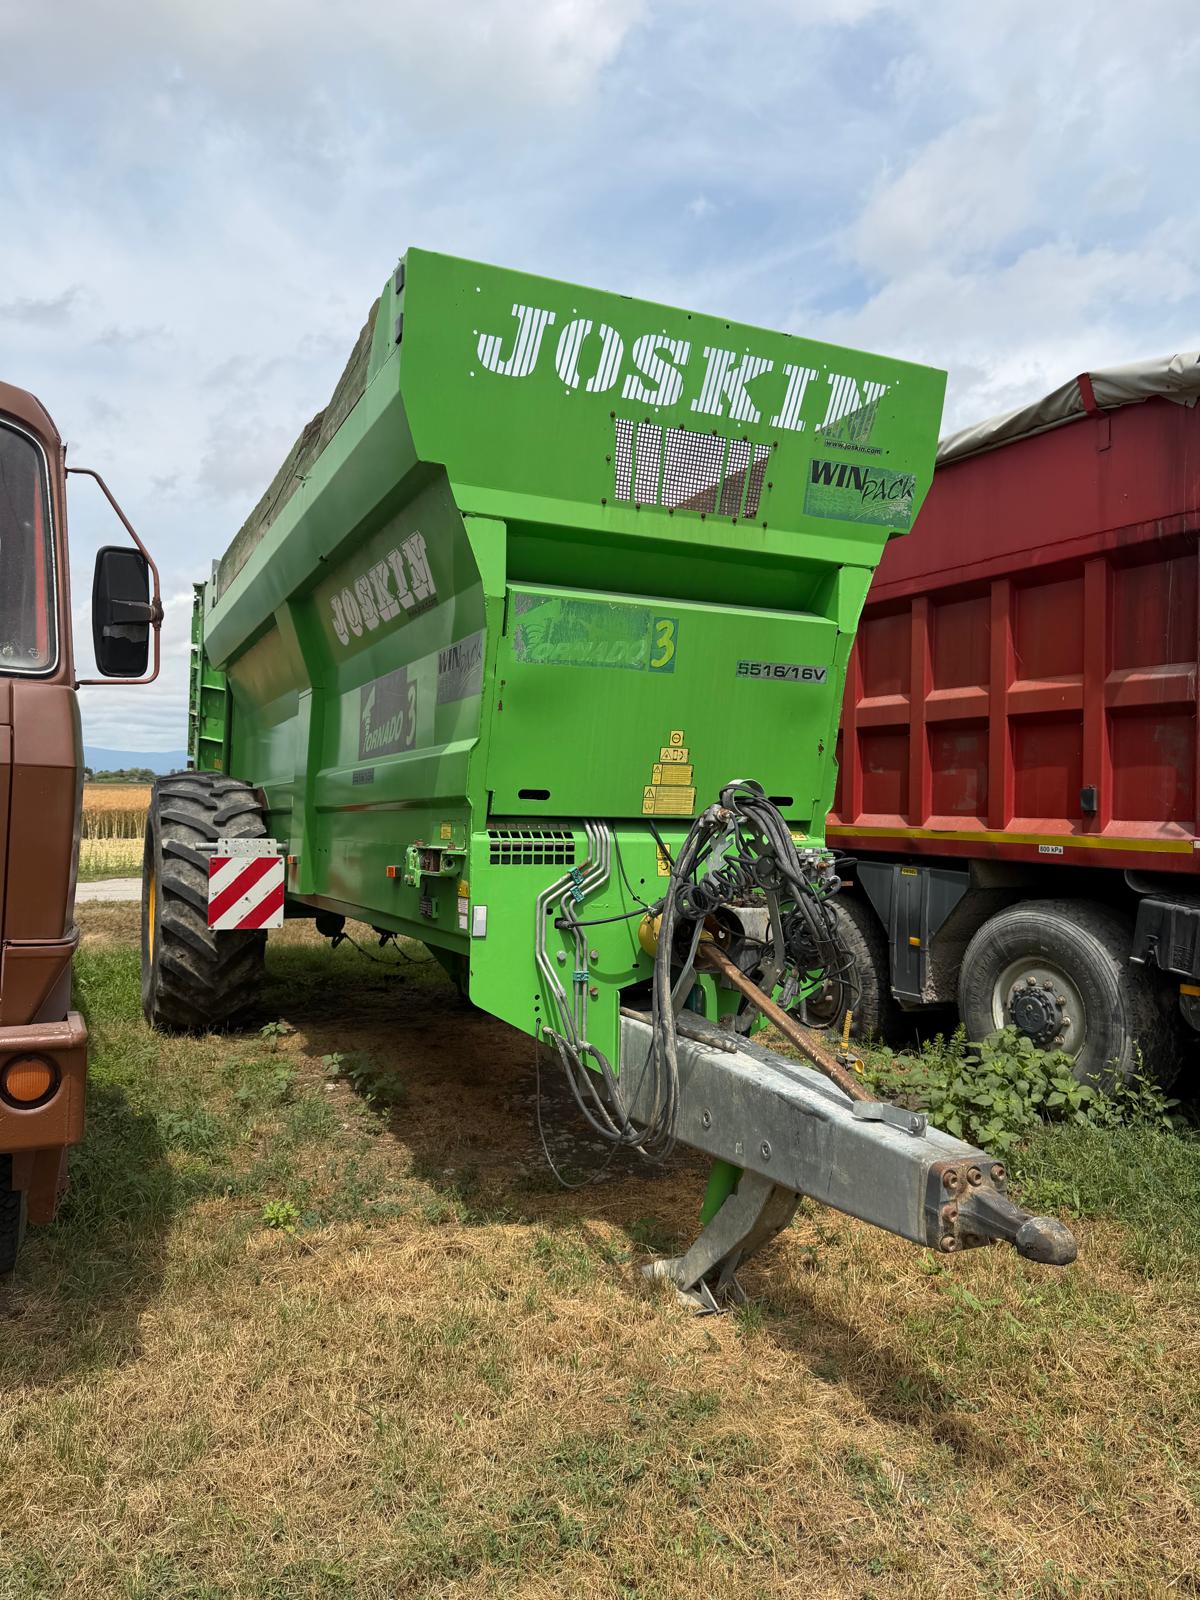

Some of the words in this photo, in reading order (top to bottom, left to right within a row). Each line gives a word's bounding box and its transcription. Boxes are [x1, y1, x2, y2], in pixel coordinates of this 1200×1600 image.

[476, 303, 891, 440] JOSKIN
[825, 439, 882, 456] www.joskin.com
[811, 460, 870, 493] WIN
[861, 477, 915, 503] PACK
[330, 530, 437, 646] JOSKIN
[438, 645, 463, 675] WIN
[651, 619, 675, 668] 3
[737, 662, 826, 681] 5516/16V
